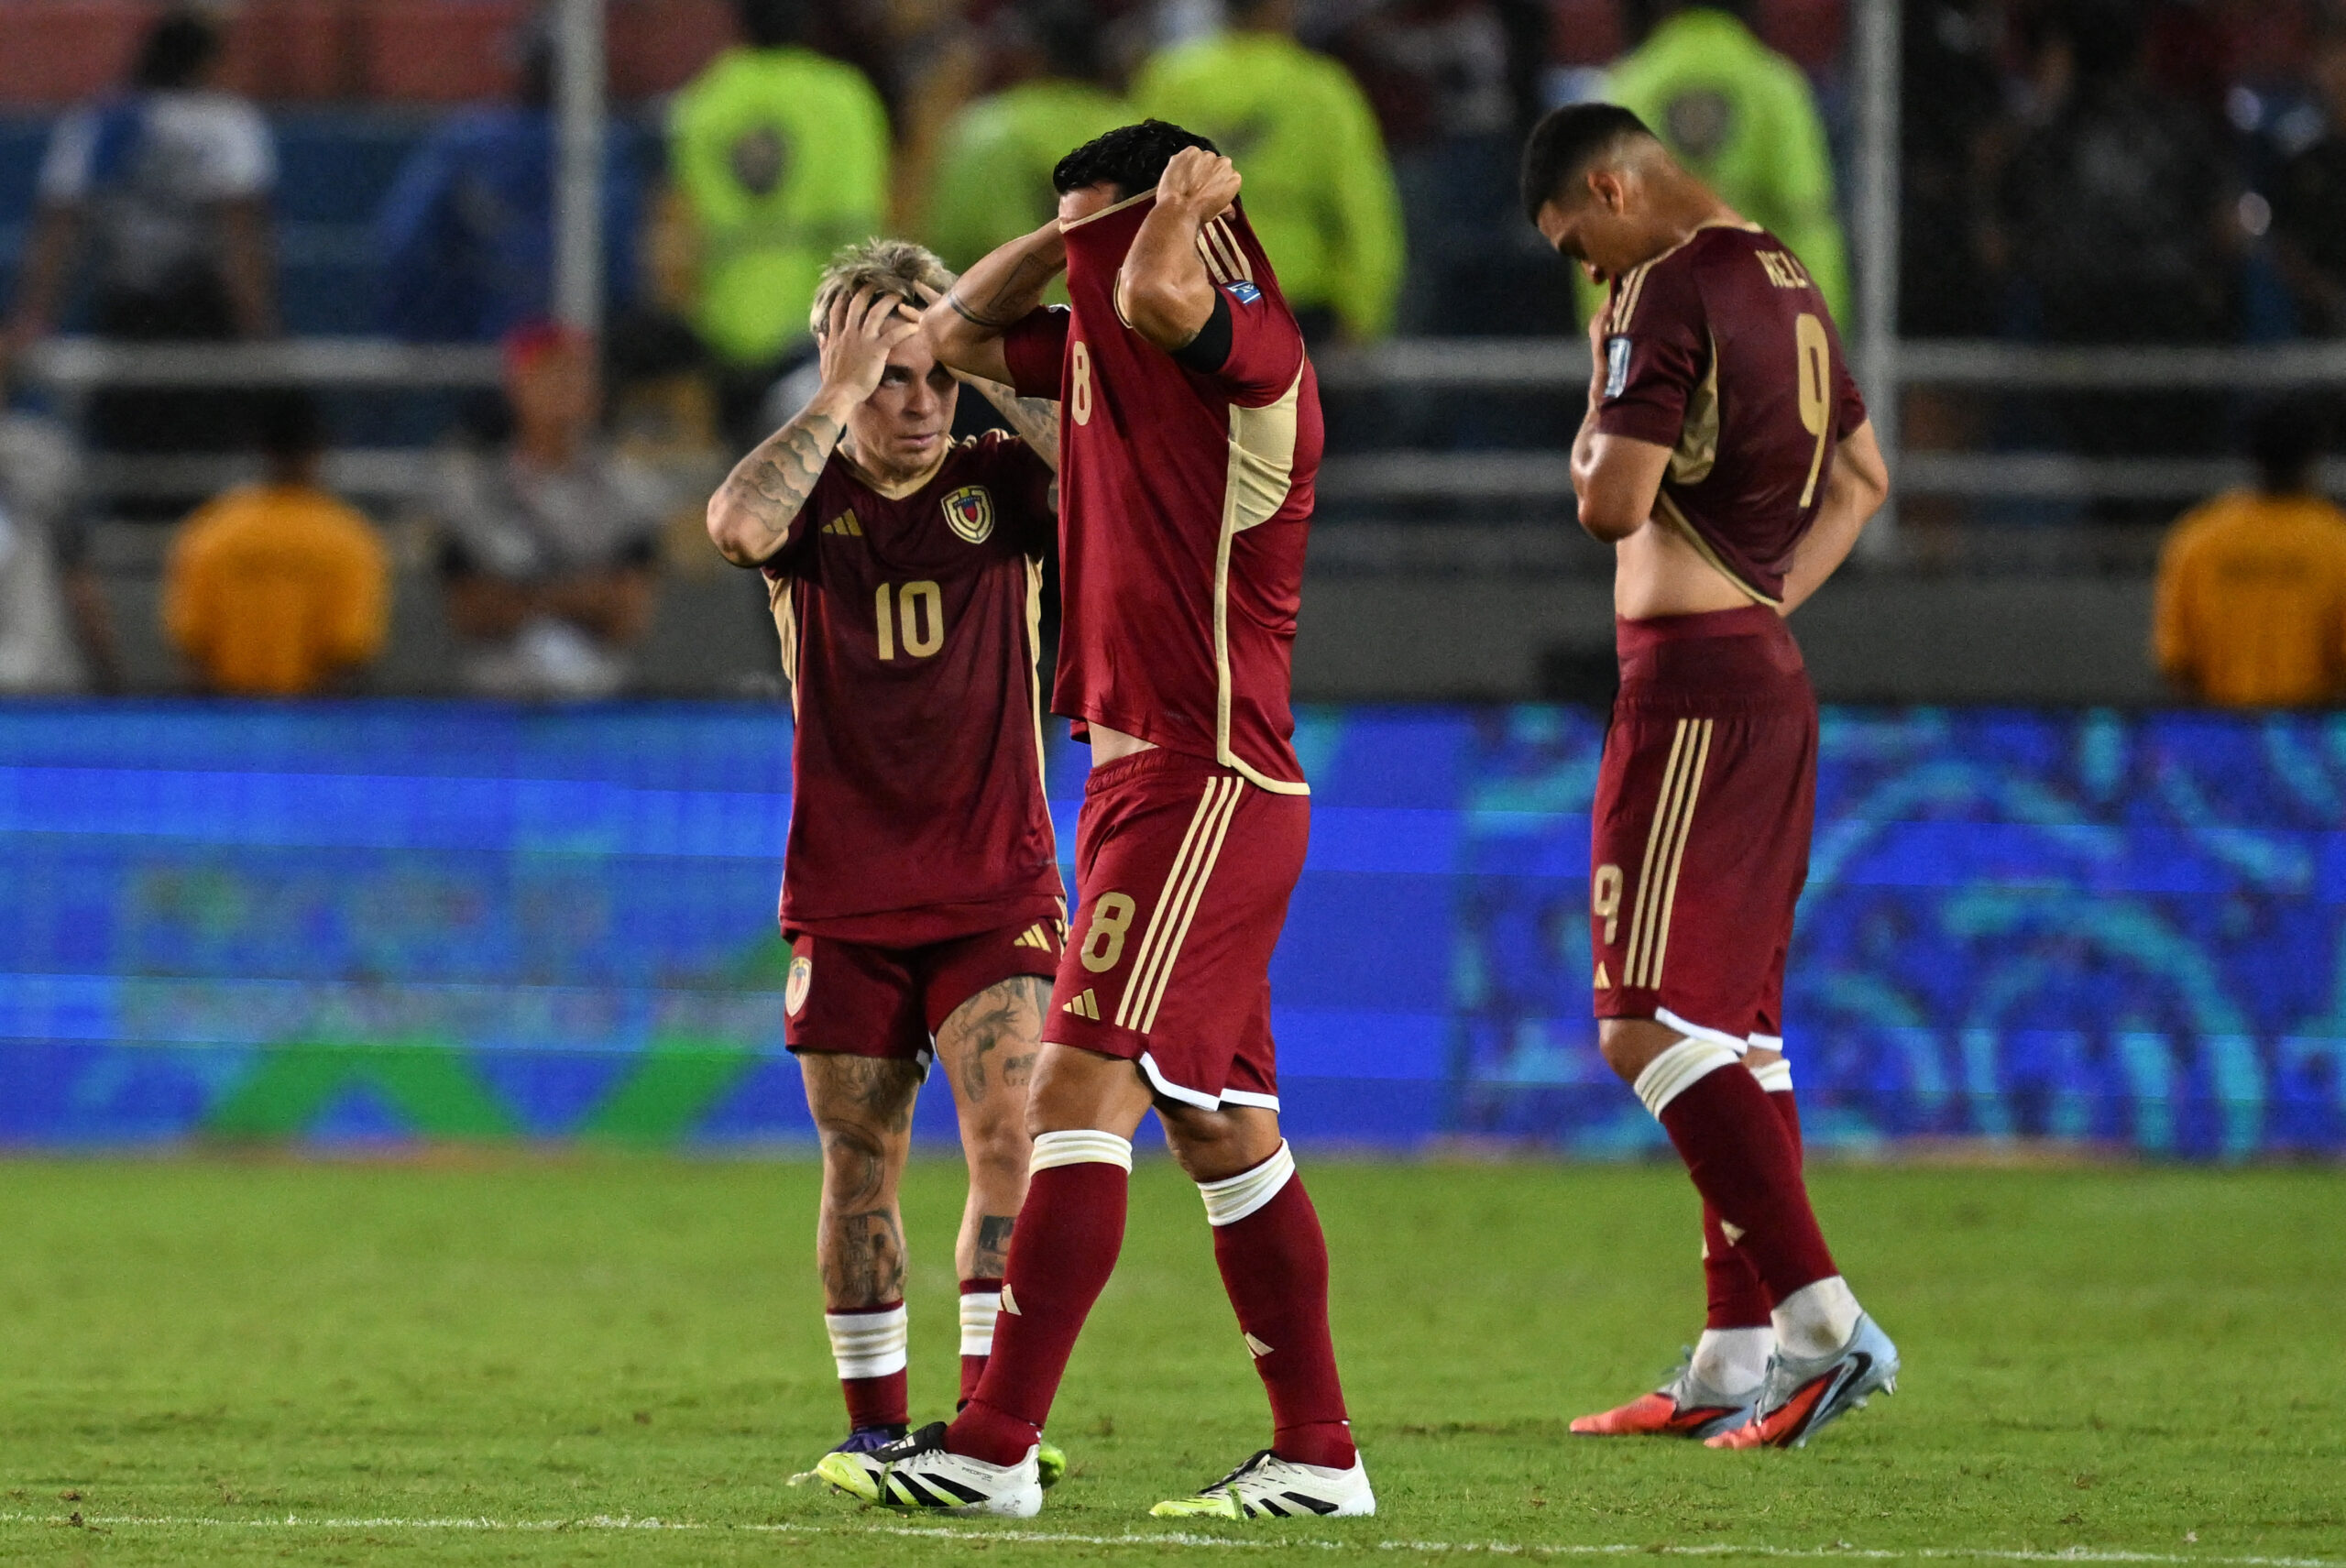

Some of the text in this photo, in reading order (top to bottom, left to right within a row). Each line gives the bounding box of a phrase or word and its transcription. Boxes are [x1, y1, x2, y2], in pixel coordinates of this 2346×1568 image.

[1071, 340, 1092, 426] 8
[1795, 313, 1830, 509] 9
[875, 580, 945, 660] 10
[1080, 892, 1136, 973] 8
[1595, 864, 1624, 945] 9
